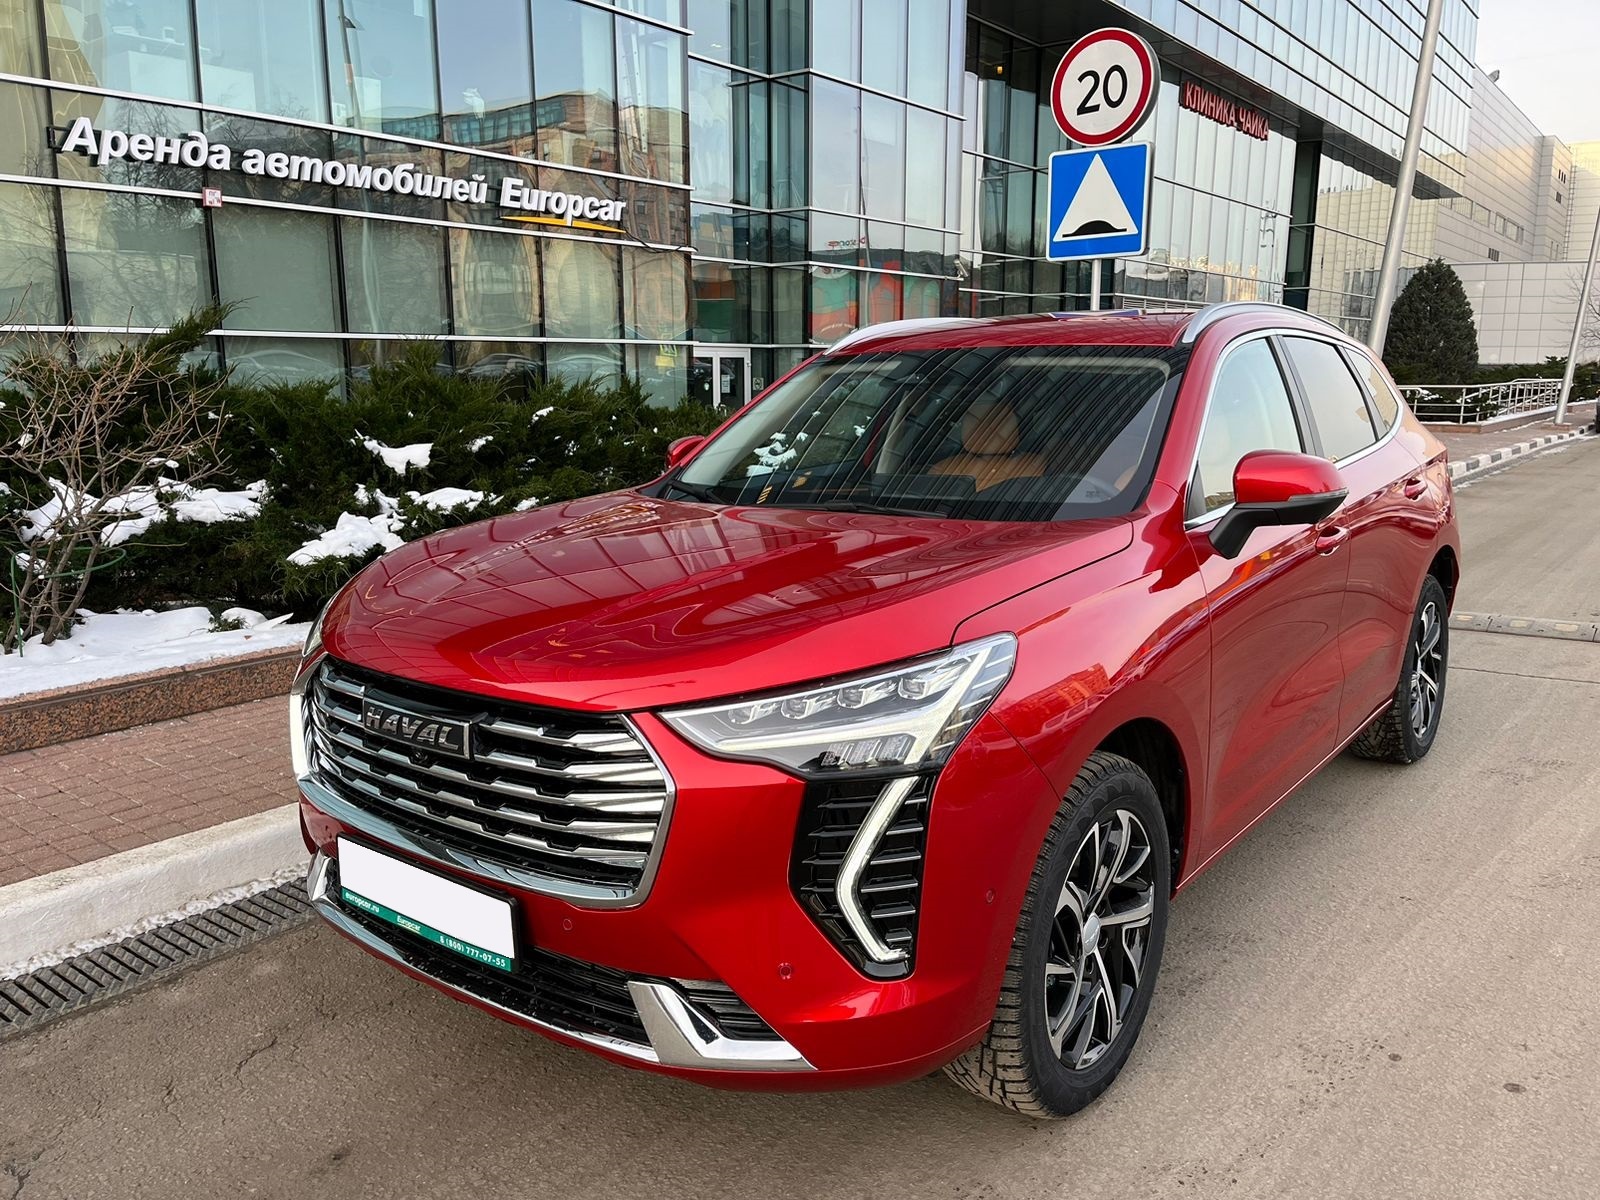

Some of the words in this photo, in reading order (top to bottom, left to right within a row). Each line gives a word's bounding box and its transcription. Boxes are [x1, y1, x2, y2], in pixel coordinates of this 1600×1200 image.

[1077, 64, 1128, 116] 20
[1185, 81, 1237, 126] КЛИНИКА
[1238, 106, 1270, 140] ЧАЙКА
[61, 116, 231, 171] Аренда
[241, 148, 488, 204] автомобилей
[500, 176, 627, 227] Europcar
[365, 706, 460, 751] HAVAL
[345, 891, 380, 913] europcar.ru
[396, 915, 421, 932] Europcar
[445, 938, 464, 952] (800)
[465, 946, 506, 968] 777-07-55
